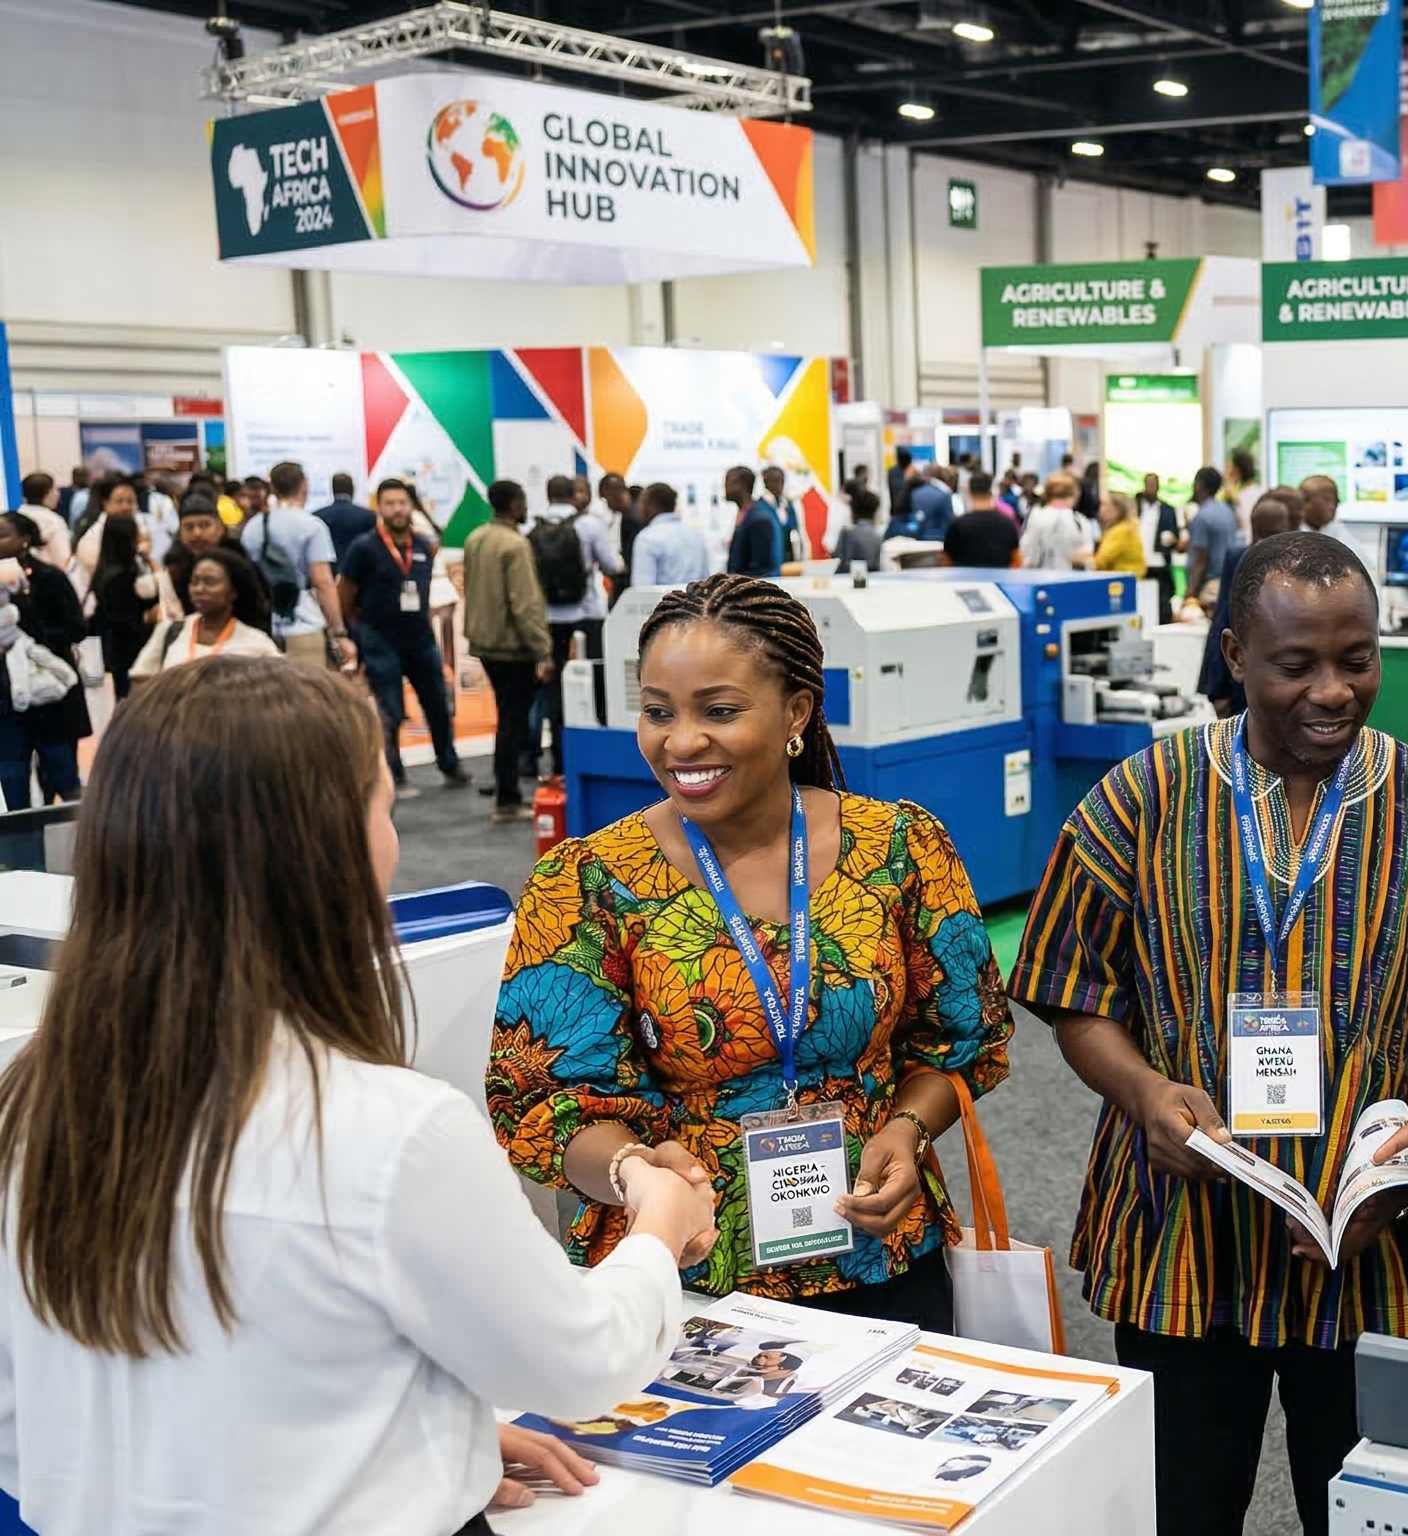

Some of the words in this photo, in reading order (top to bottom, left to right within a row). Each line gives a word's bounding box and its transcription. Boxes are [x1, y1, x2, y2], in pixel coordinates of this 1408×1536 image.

[543, 113, 672, 157] GLOBAL
[269, 136, 329, 179] TECH
[545, 151, 739, 201] INNOVATION
[272, 175, 331, 209] AFRICA
[546, 190, 615, 222] HUB
[295, 204, 334, 233] 2024
[1001, 280, 1145, 304] AGRICULTURE
[1149, 278, 1166, 300] &
[1012, 304, 1156, 328] RENEWABLES
[1278, 303, 1294, 323] &
[1256, 1046, 1293, 1055] GHANA
[771, 1185, 830, 1203] OKONKWO
